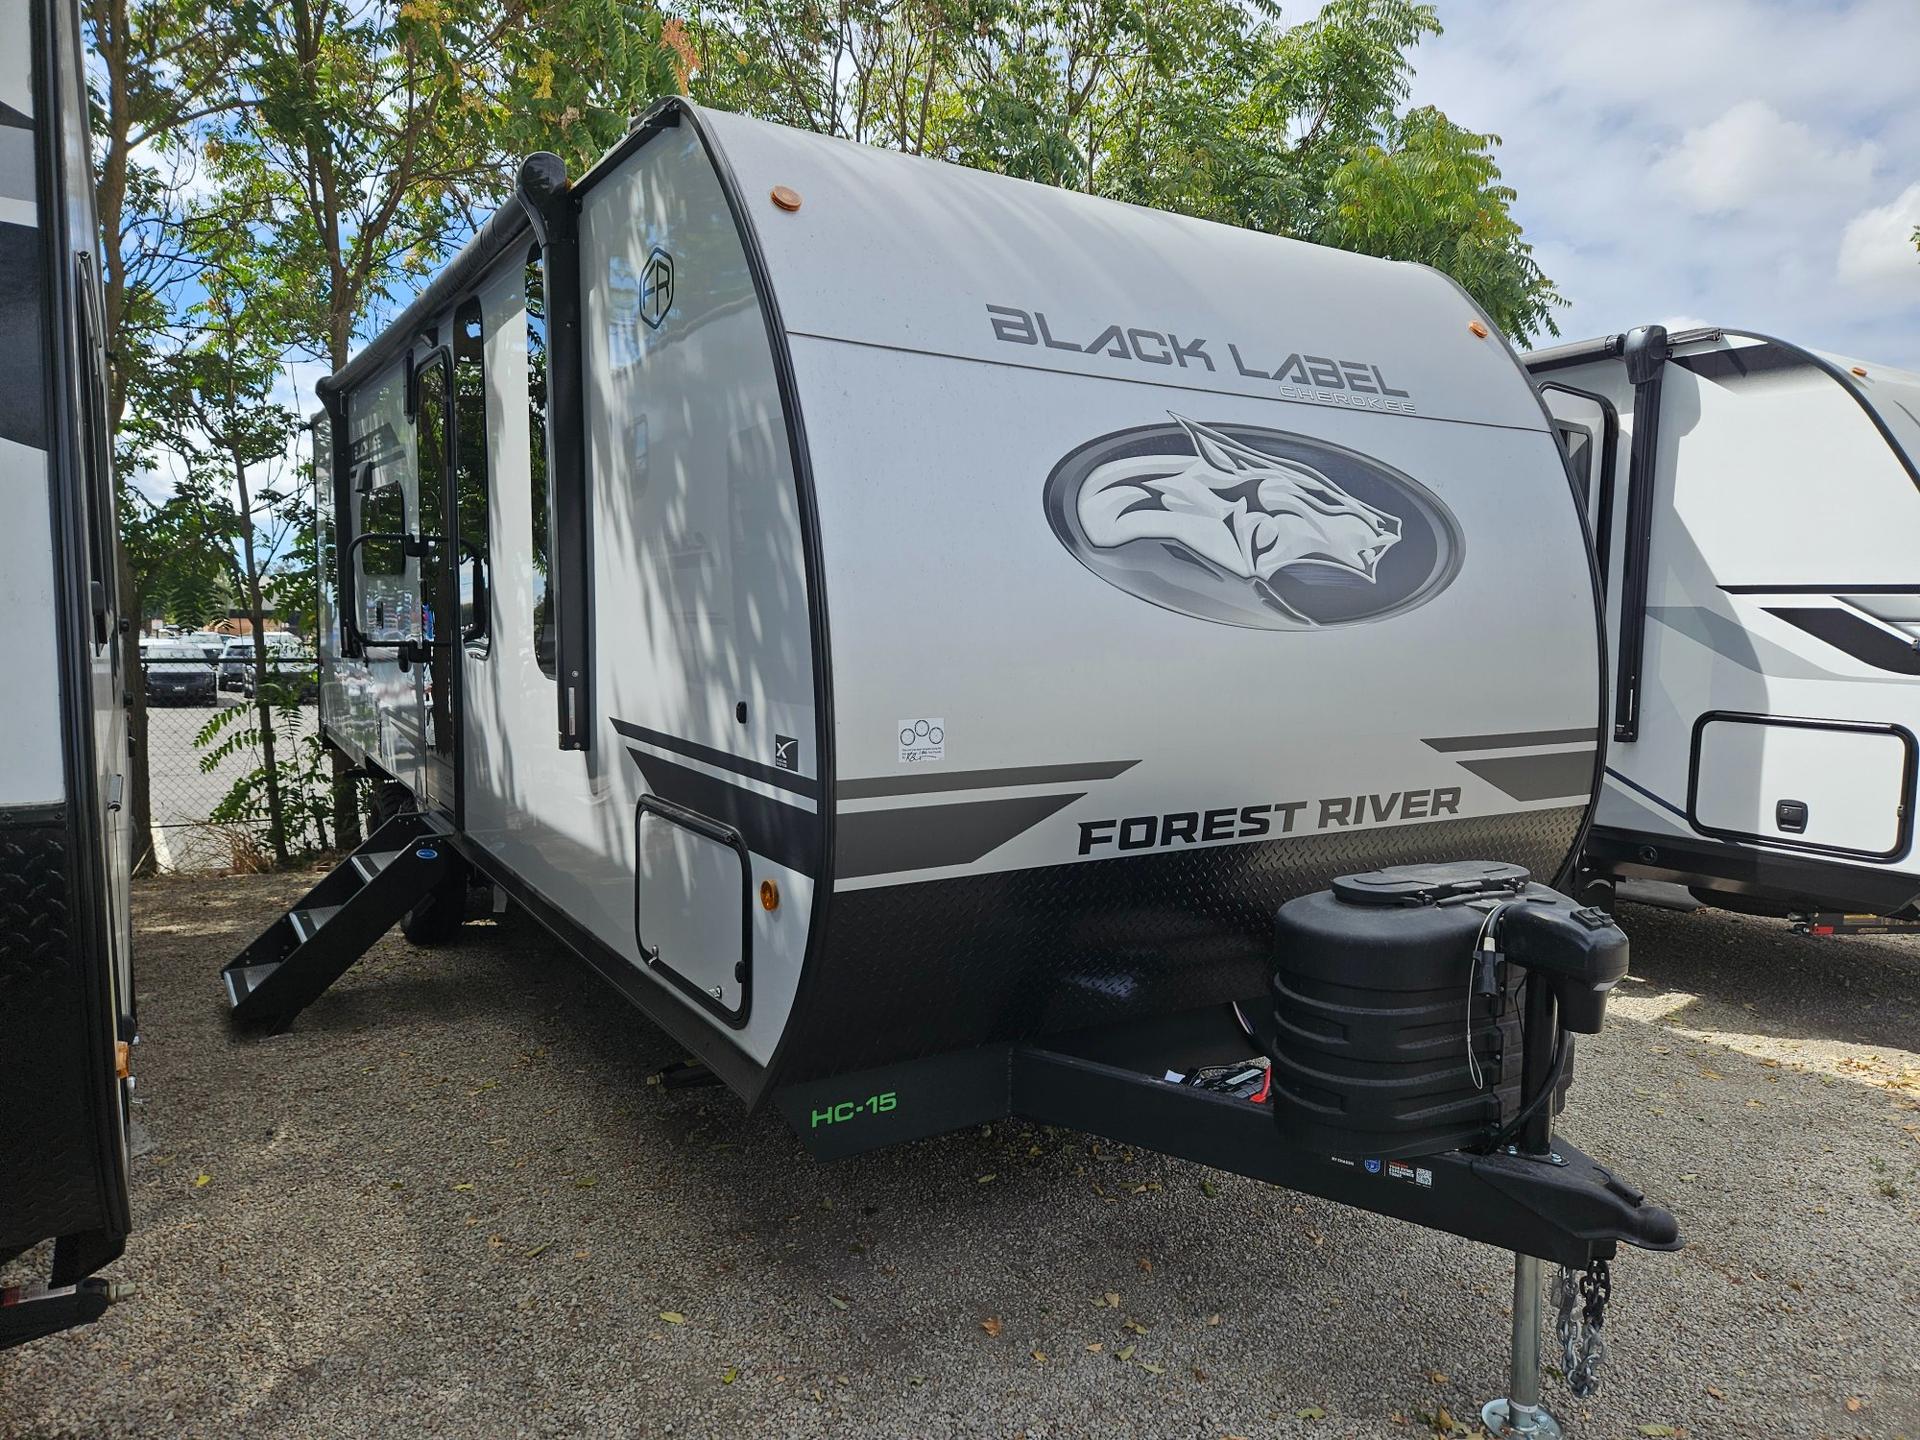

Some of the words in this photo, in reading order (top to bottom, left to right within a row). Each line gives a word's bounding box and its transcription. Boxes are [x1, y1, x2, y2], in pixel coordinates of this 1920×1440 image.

[986, 303, 1216, 372] BLACK
[1227, 343, 1410, 399] LABEL
[1279, 385, 1417, 414] CHEROKEE
[1077, 800, 1308, 856] FOREST
[1318, 786, 1462, 830] RIVER
[811, 1091, 898, 1129] HC-15
